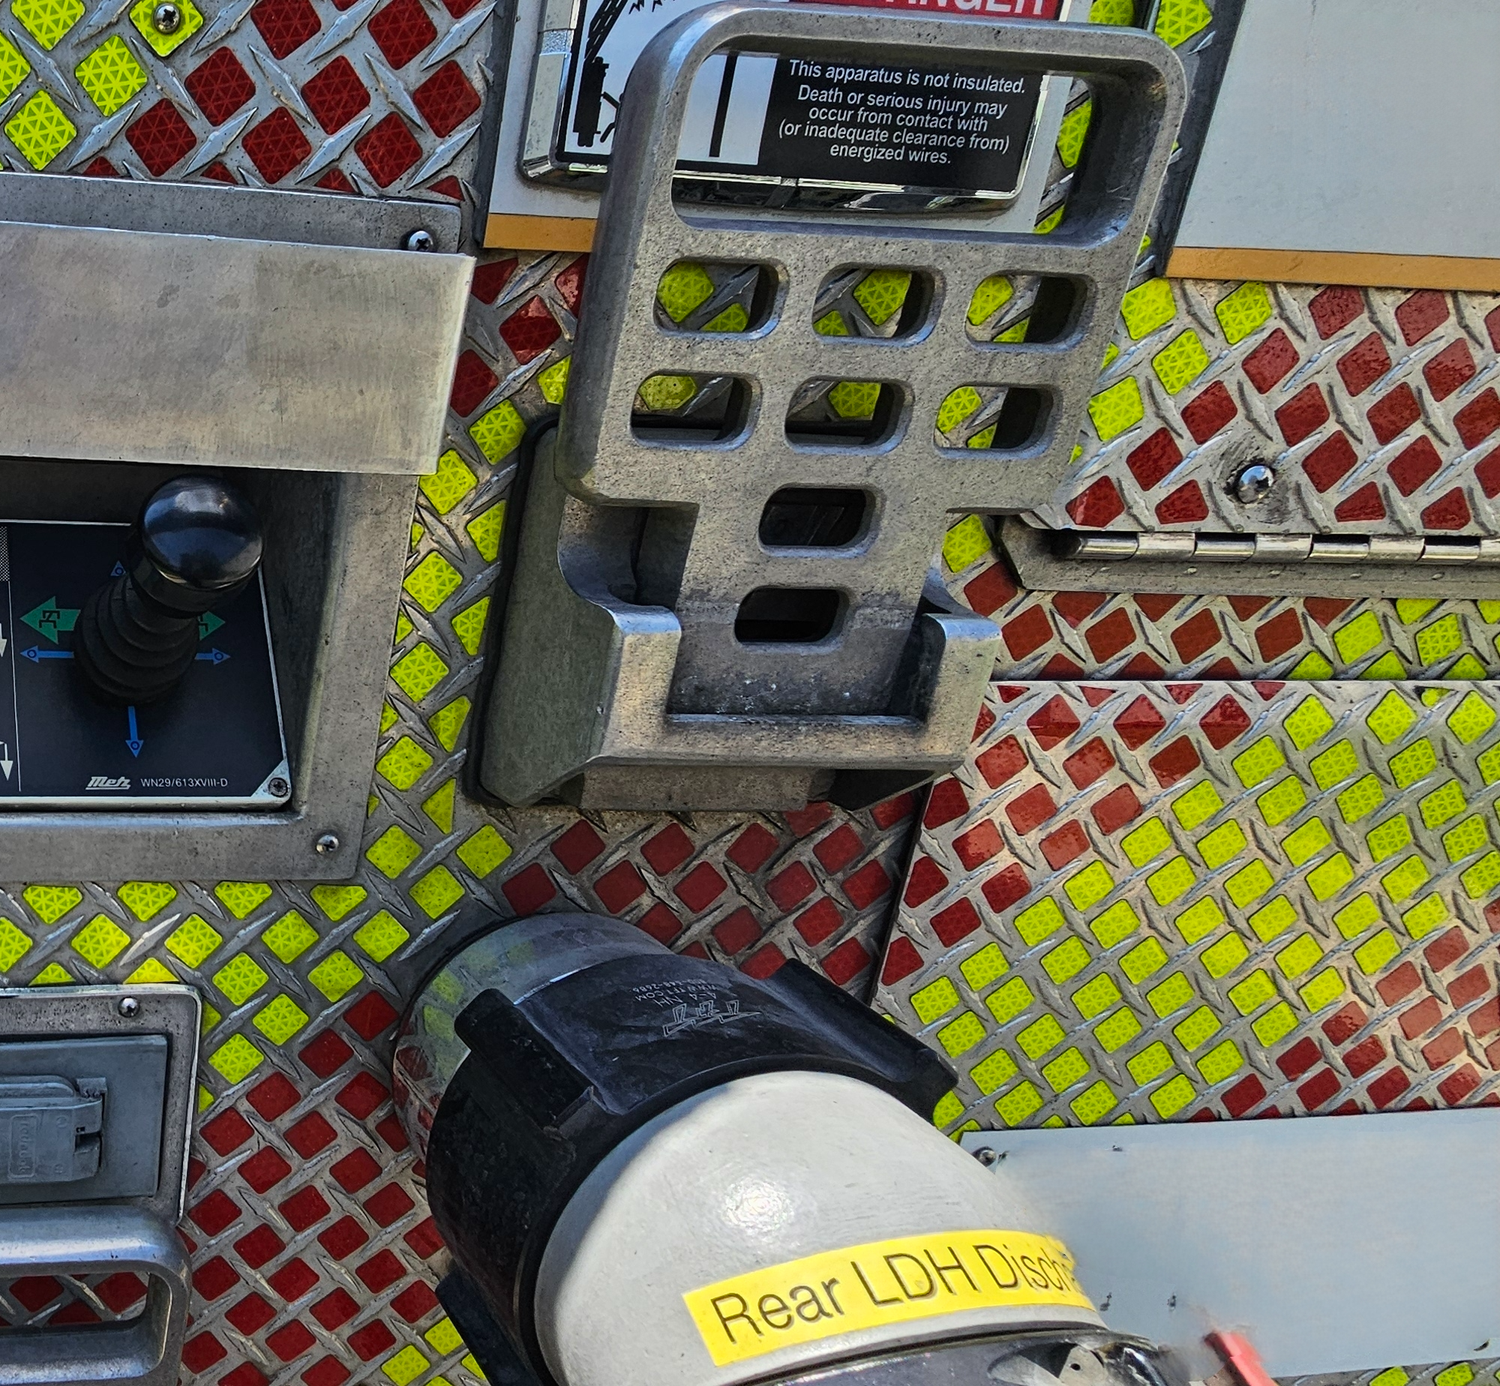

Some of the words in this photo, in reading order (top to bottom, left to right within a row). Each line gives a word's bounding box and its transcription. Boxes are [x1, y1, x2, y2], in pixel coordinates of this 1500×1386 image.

[789, 59, 822, 78] This
[825, 65, 902, 84] apparatus
[906, 69, 920, 86] is
[924, 71, 950, 88] not
[952, 72, 1026, 94] insulated.
[798, 84, 842, 103] Death
[847, 91, 864, 104] or
[866, 91, 923, 109] serious
[927, 95, 971, 117] injury
[974, 101, 1008, 119] may
[809, 106, 854, 121] occur
[857, 106, 893, 124] from
[896, 110, 953, 129] contact
[956, 115, 989, 132] with
[778, 118, 802, 138] (or
[804, 122, 889, 143] inadequate
[892, 128, 966, 148] clearance
[969, 133, 1011, 154] from)
[830, 142, 904, 162] energized
[908, 148, 952, 164] wires.
[85, 776, 131, 790] Metz
[710, 1277, 846, 1344] Rear
[850, 1246, 981, 1306] LDH
